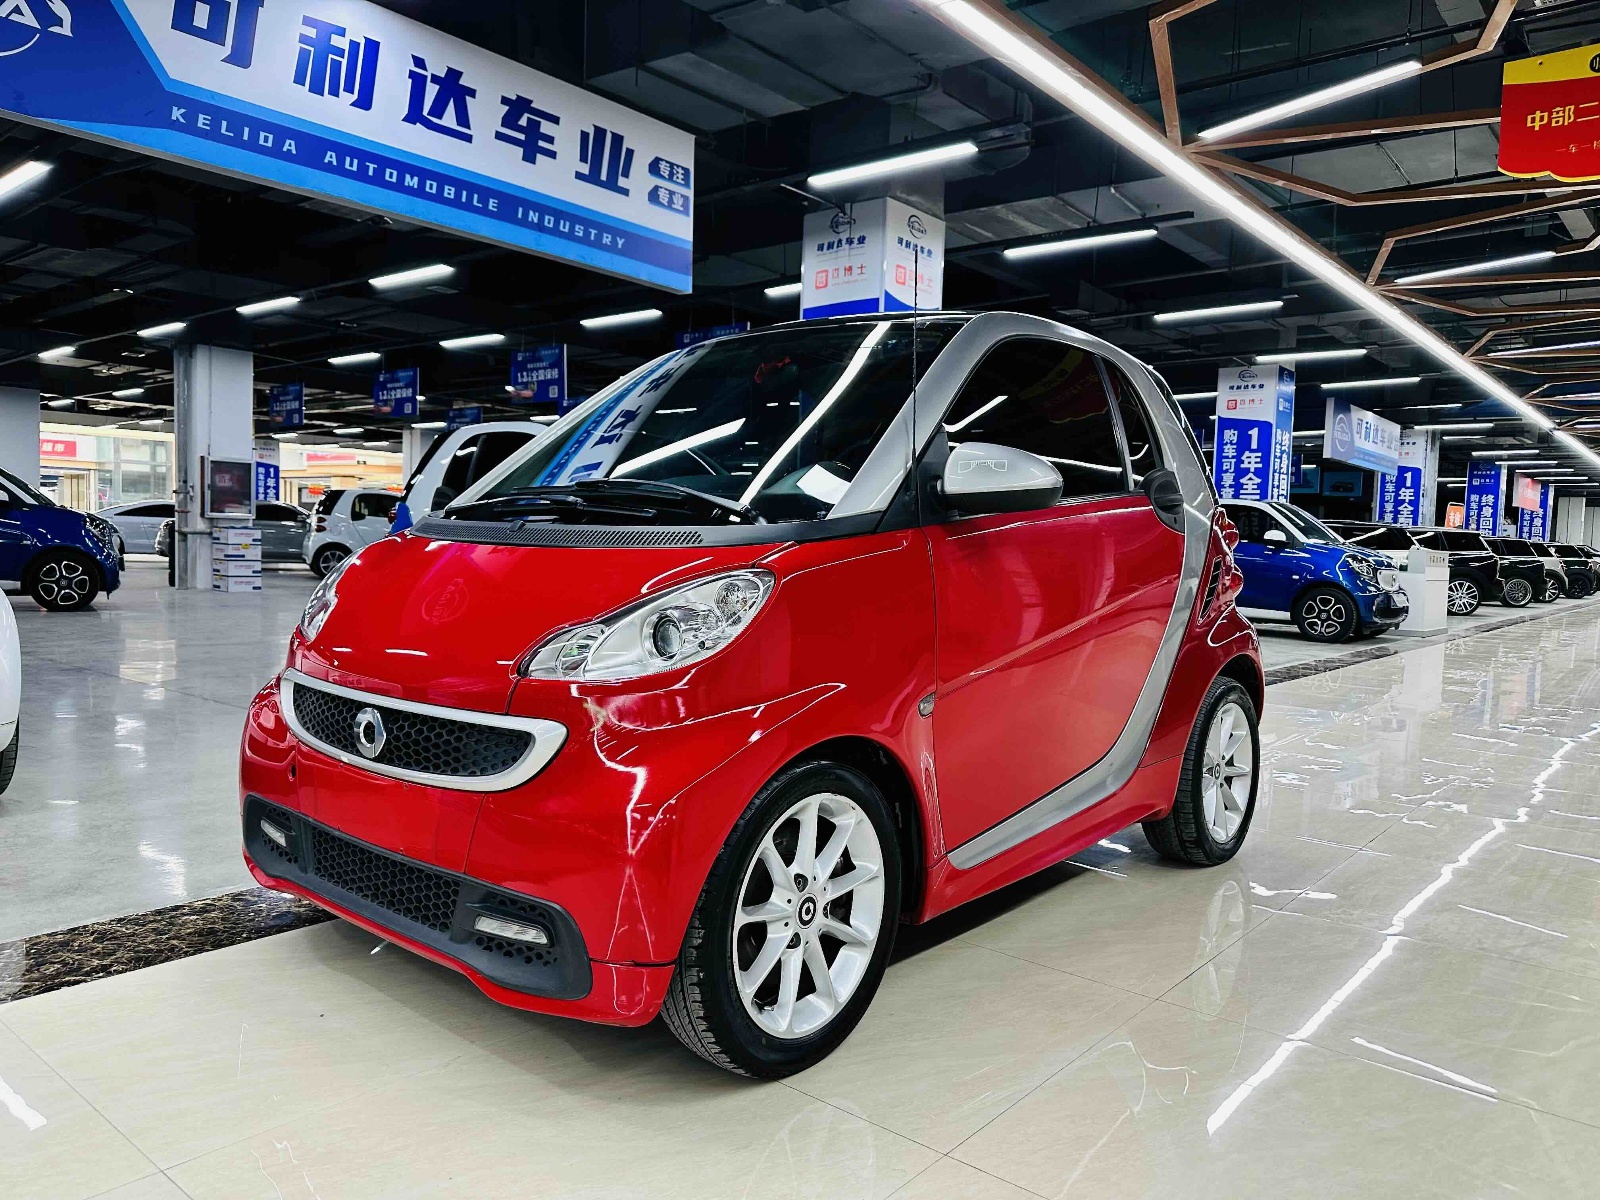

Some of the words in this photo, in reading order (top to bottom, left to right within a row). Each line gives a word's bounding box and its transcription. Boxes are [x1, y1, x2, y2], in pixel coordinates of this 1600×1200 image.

[171, 0, 635, 197] 可利达车业
[1527, 101, 1600, 131] 中部二
[171, 105, 297, 155] KELIDA
[324, 150, 499, 212] AUTOMOBILE
[518, 206, 625, 249] INDUSTRY
[658, 160, 685, 185] 专注
[657, 187, 684, 211] 专业
[1239, 427, 1263, 500] 1年全
